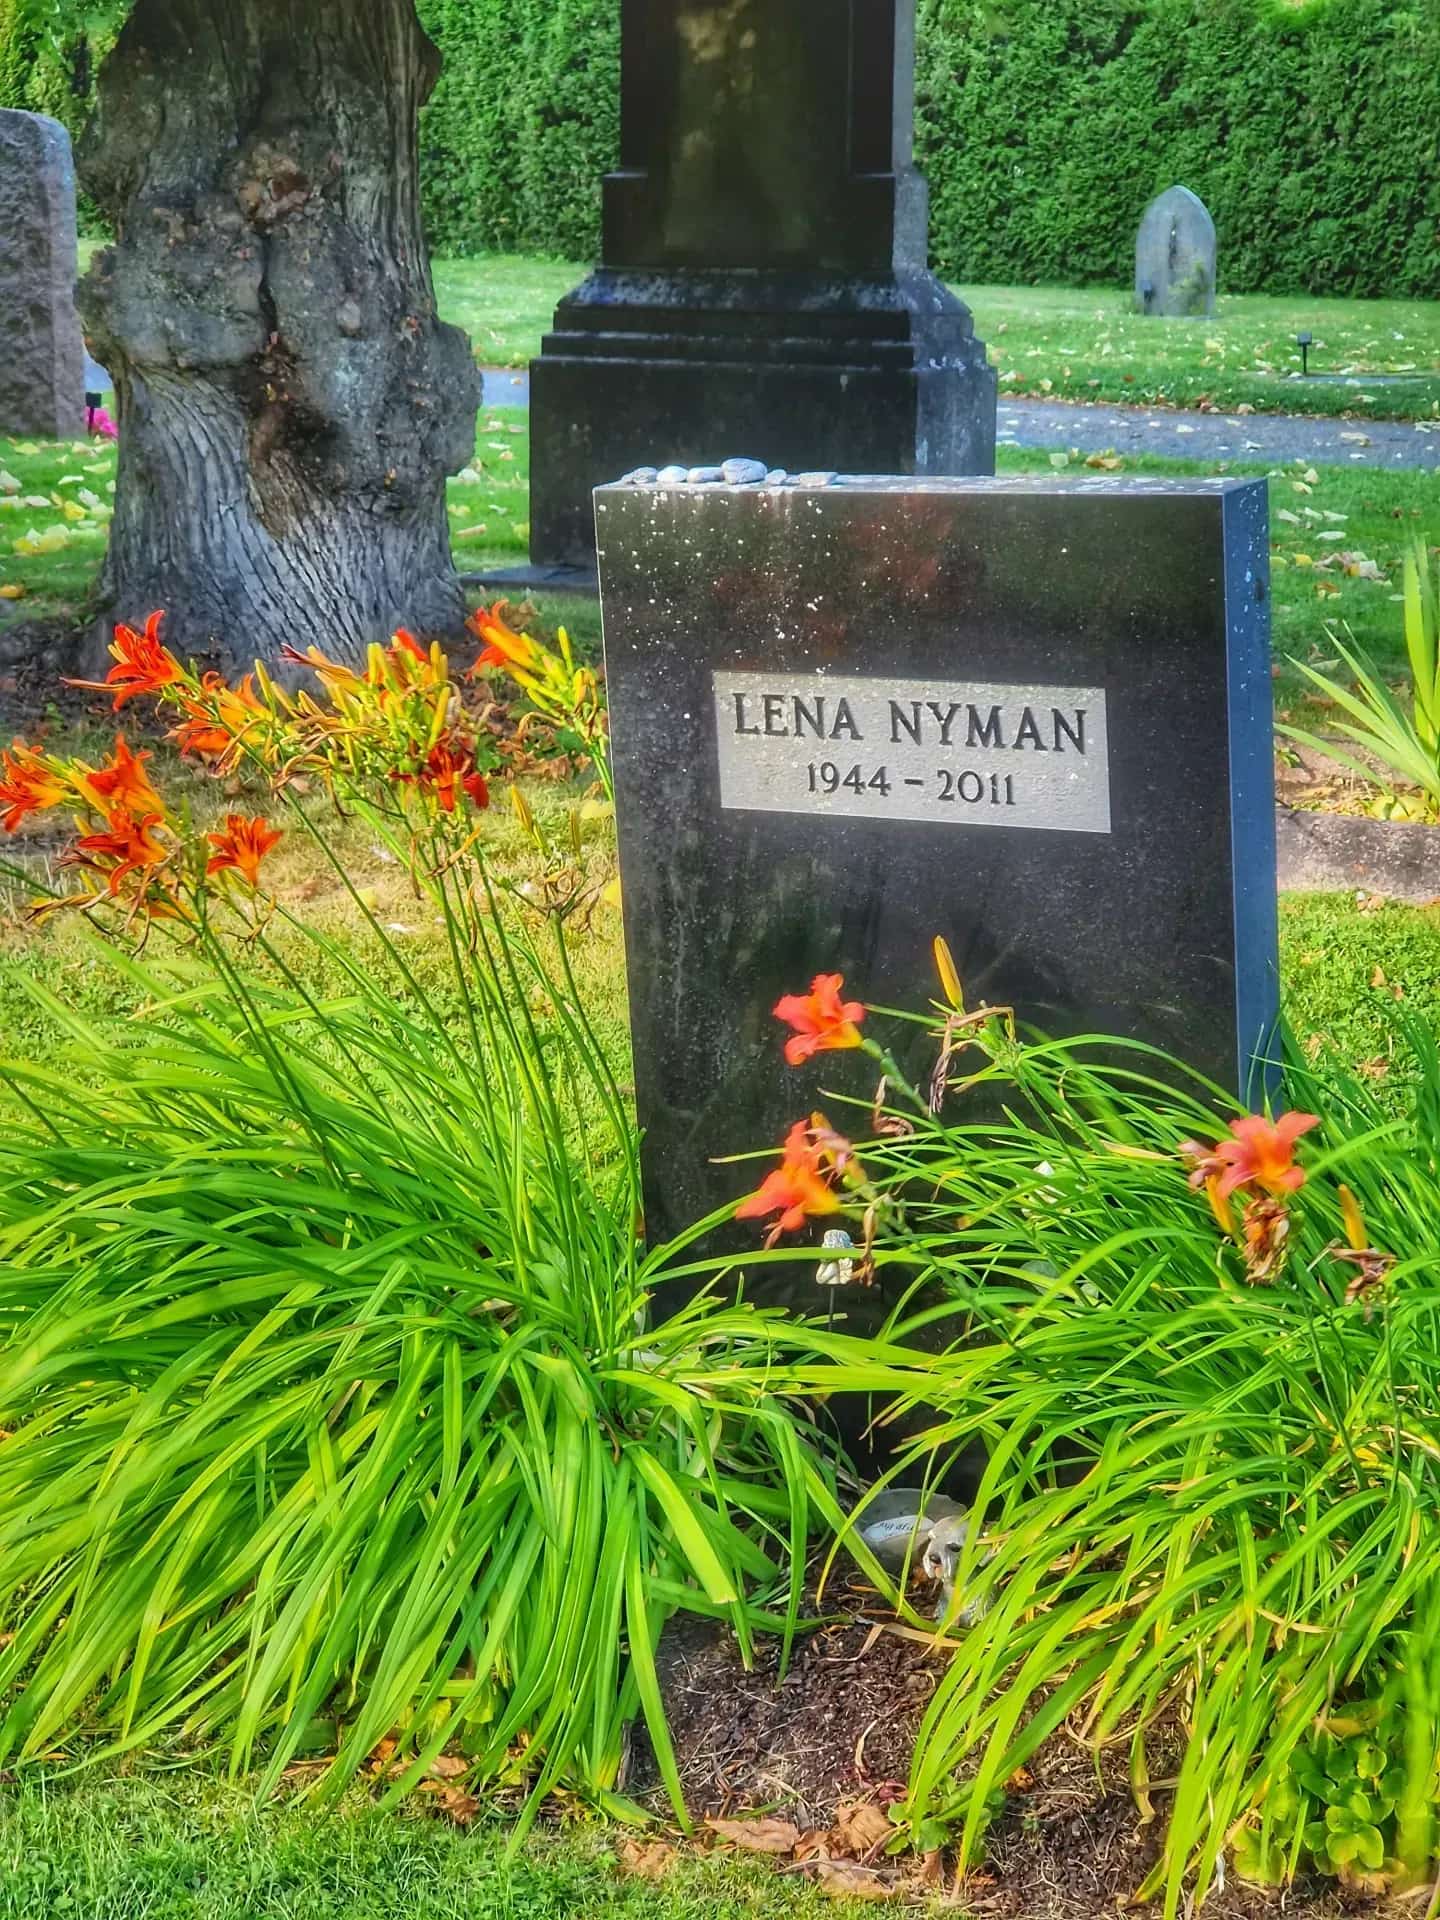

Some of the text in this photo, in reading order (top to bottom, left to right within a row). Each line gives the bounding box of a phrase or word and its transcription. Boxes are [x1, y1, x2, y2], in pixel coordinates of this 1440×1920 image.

[733, 693, 1087, 754] LENA NYMAN
[808, 762, 891, 797] 1944
[938, 770, 1016, 805] 2011
